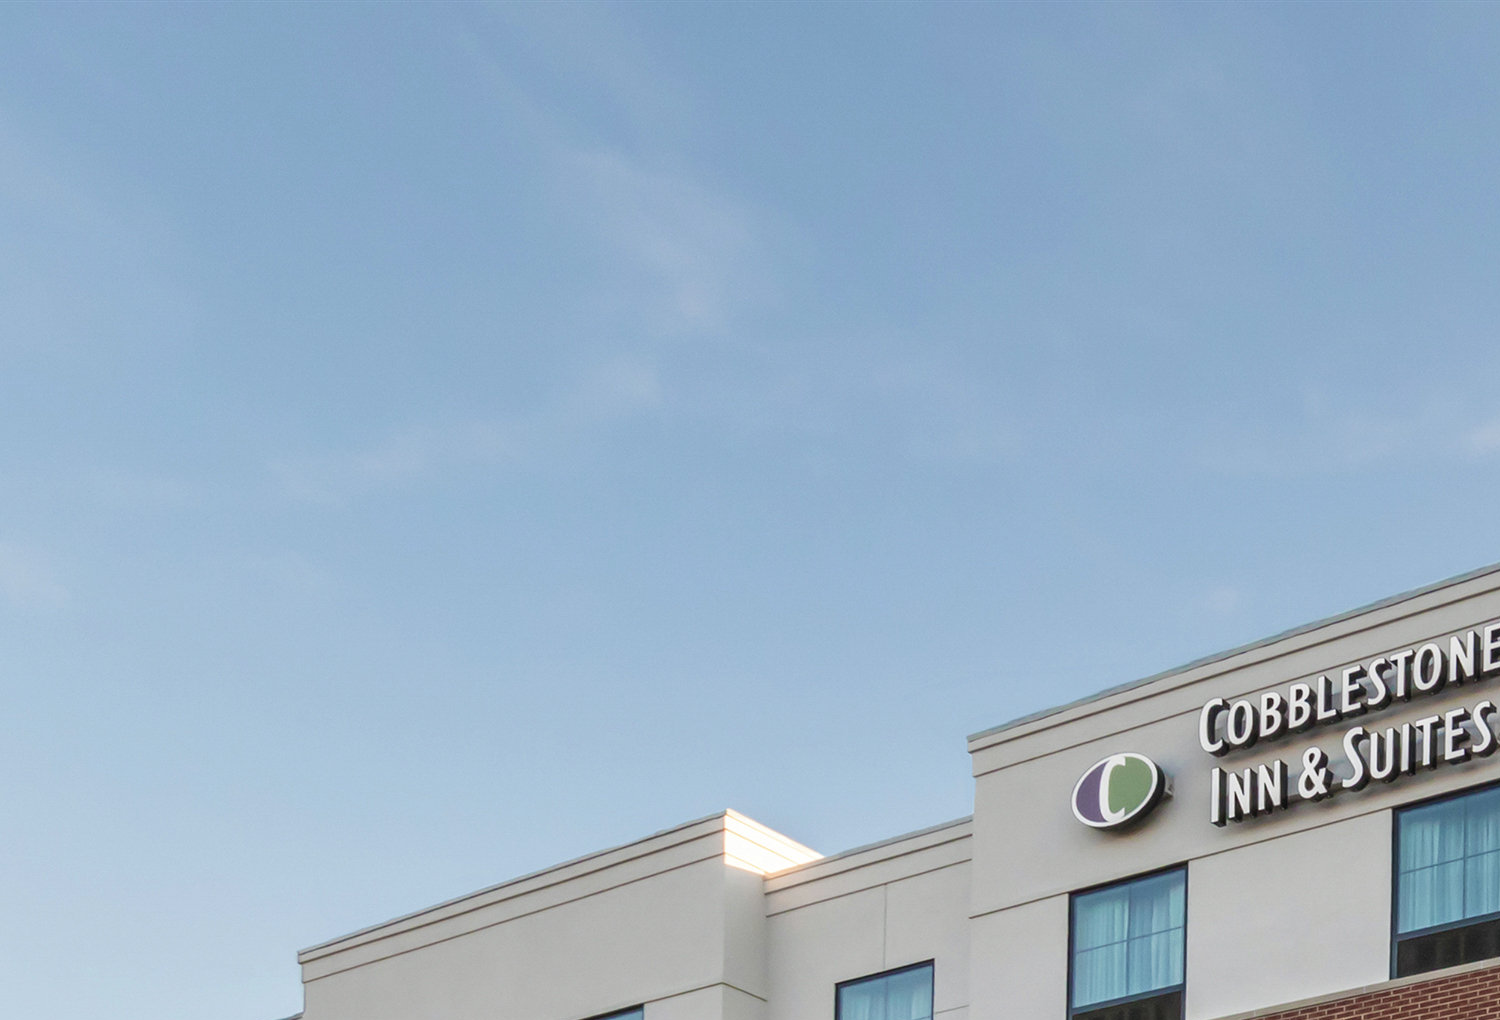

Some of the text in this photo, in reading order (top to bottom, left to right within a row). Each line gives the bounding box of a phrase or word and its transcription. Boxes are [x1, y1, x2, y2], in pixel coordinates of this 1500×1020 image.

[1210, 700, 1497, 826] INN & SUITES
